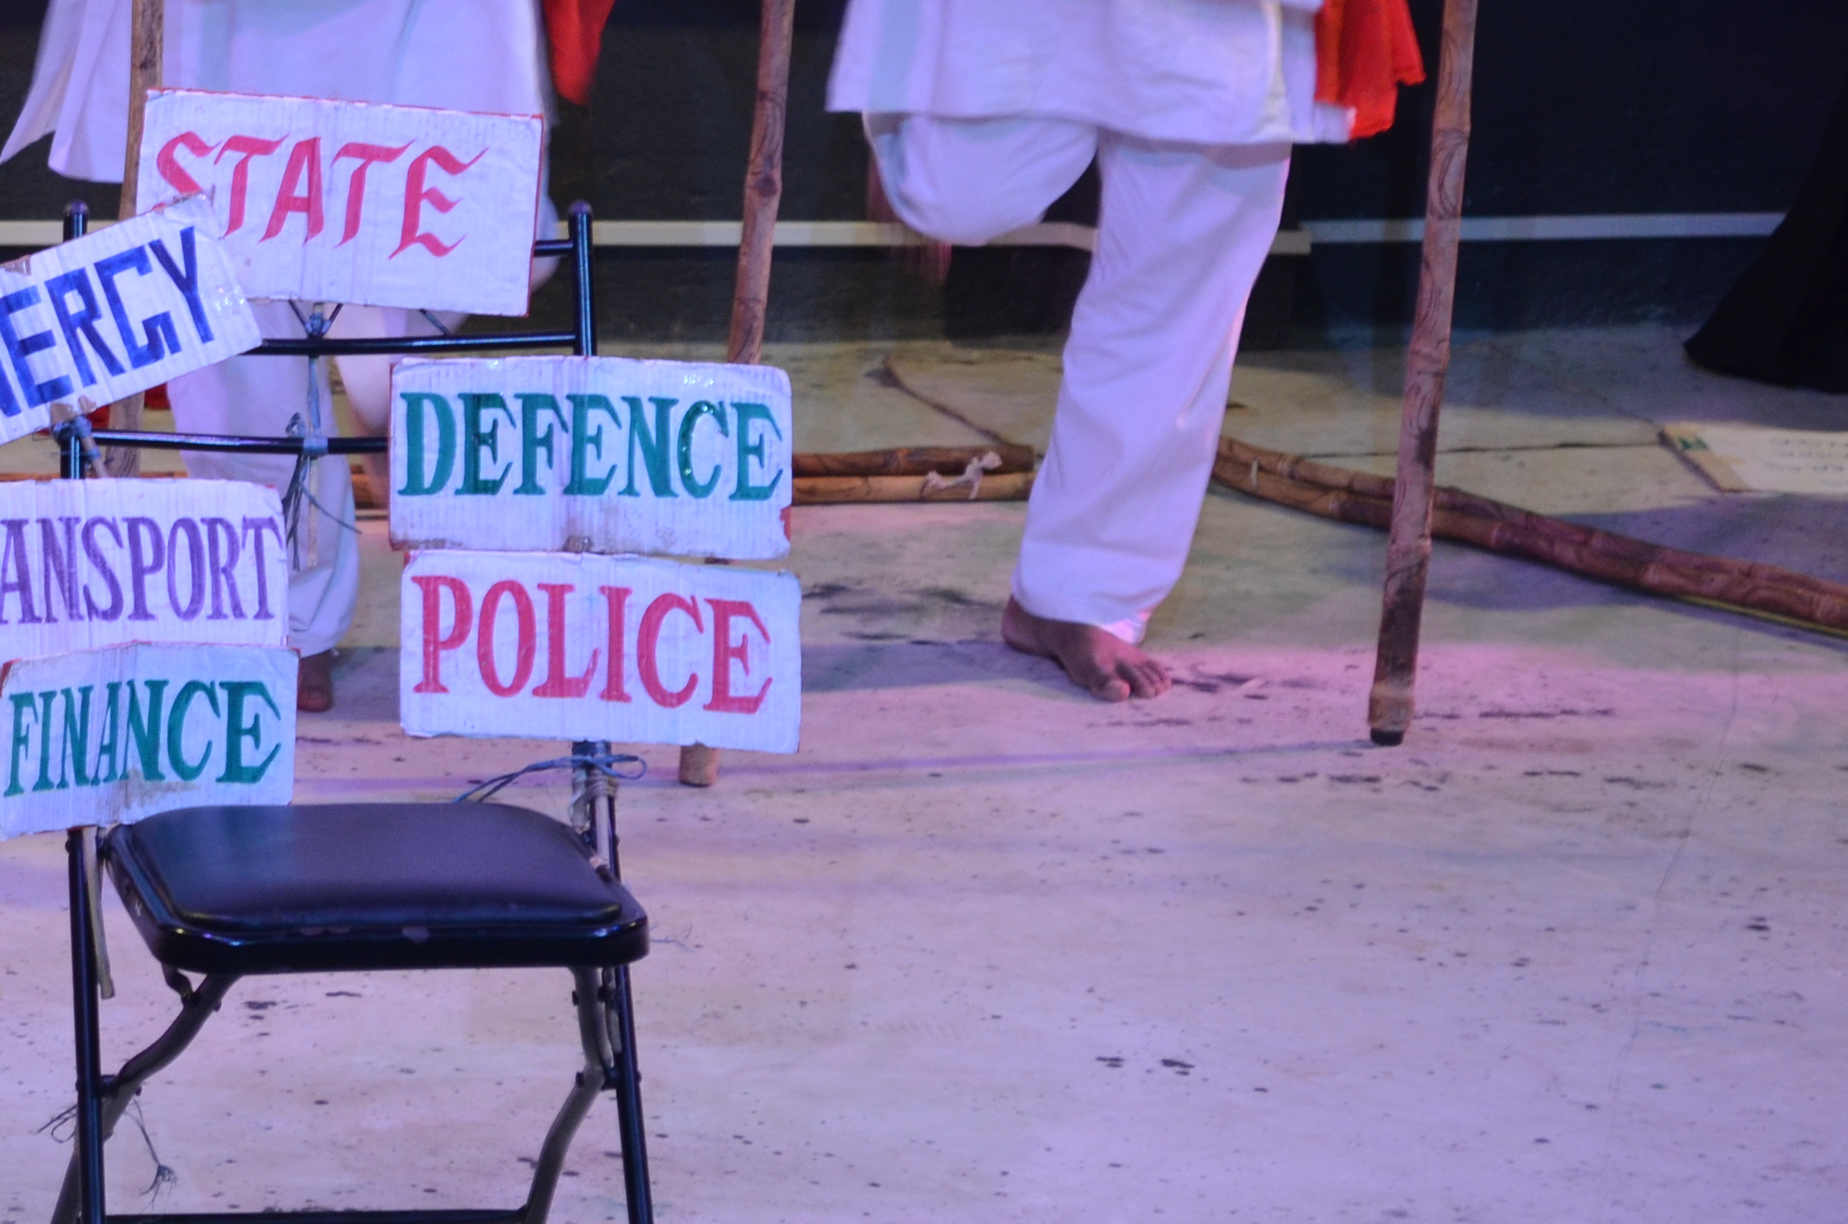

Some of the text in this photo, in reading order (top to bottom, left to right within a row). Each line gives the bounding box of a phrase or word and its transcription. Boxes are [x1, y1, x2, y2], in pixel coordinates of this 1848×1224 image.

[155, 131, 490, 260] STATE
[397, 392, 784, 503] DEFENCE
[410, 575, 773, 713] POLICE
[4, 678, 281, 797] FINANCE
